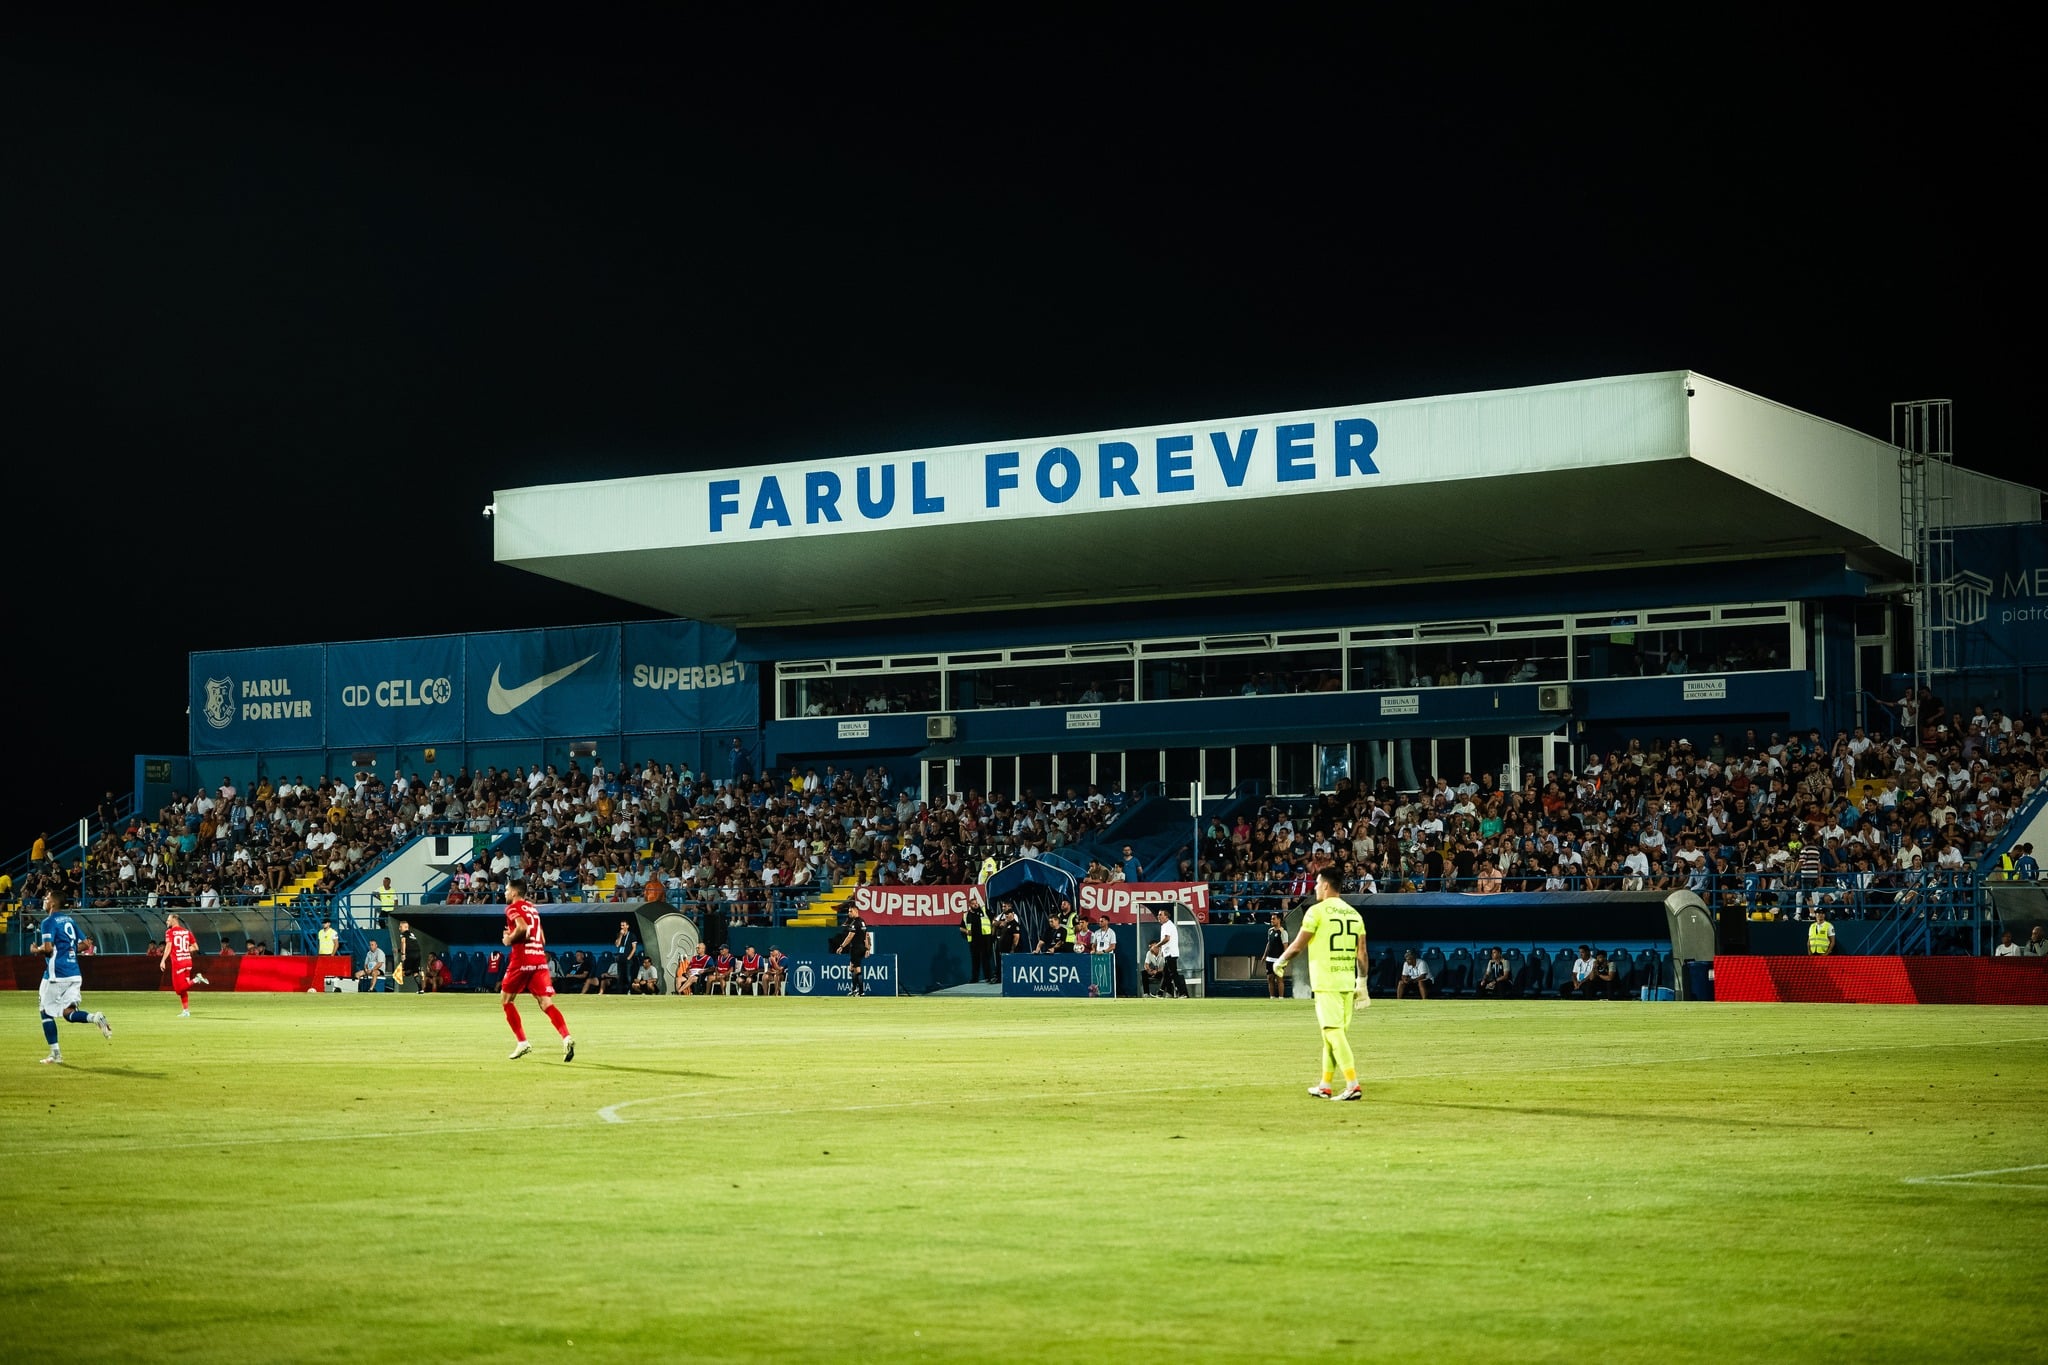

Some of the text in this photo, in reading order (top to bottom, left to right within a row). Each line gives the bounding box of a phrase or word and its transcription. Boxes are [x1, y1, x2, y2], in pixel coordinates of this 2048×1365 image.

[709, 417, 1380, 533] FARUL FOREVER
[632, 659, 745, 690] SUPERBET
[242, 678, 292, 698] FARUL
[375, 677, 452, 707] CELCO
[242, 700, 312, 721] FOREVER
[855, 886, 985, 917] SUPERLIGA
[64, 922, 77, 947] 9
[525, 913, 541, 942] 27
[1329, 918, 1359, 952] 25
[173, 935, 190, 953] 96
[821, 965, 855, 980] HOTE
[863, 965, 888, 980] IAKI
[1012, 966, 1081, 984] IAKI SPA
[1033, 984, 1060, 992] MAMAIA
